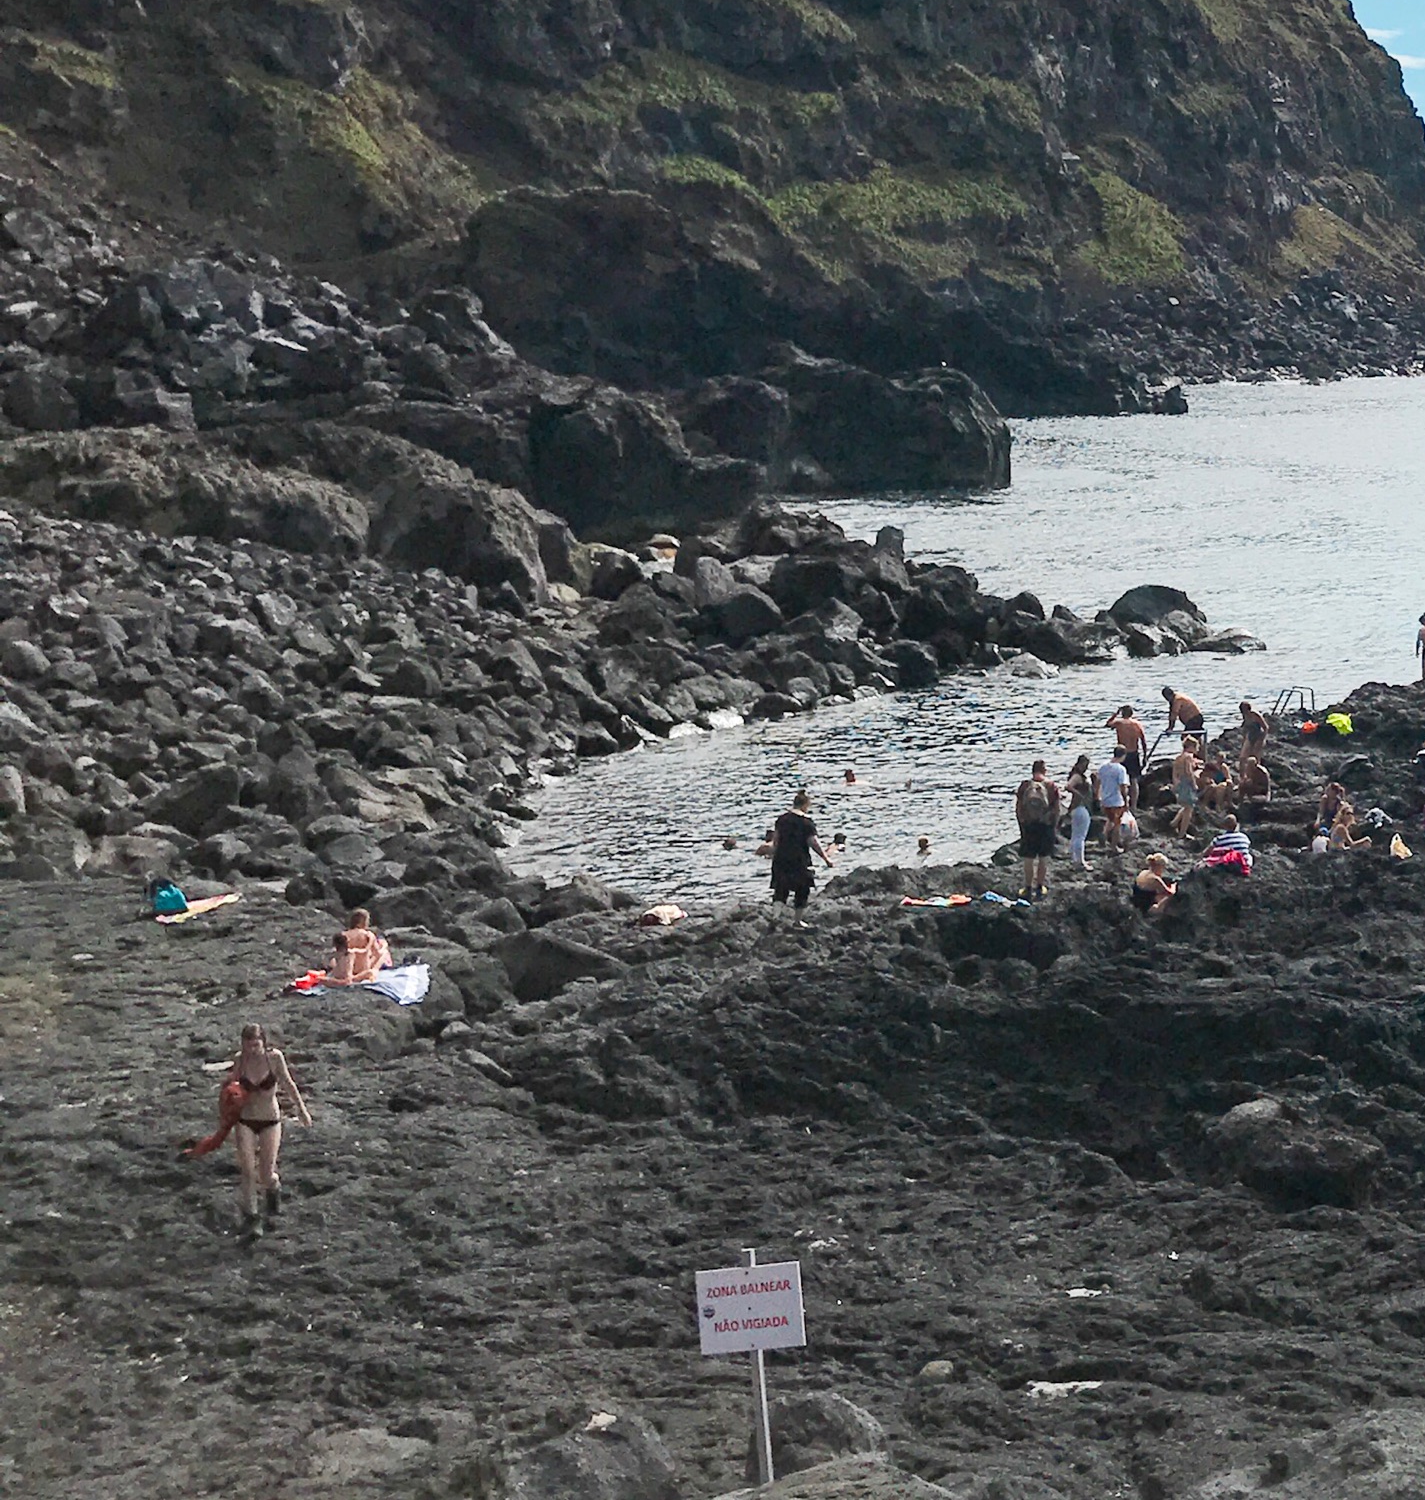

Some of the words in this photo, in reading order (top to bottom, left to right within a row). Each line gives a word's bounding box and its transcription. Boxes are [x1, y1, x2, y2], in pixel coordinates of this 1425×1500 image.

[706, 1285, 737, 1298] ZONA
[740, 1280, 791, 1295] BALNEAR
[714, 1317, 739, 1332] NÃO
[742, 1316, 788, 1329] VIGIADA
